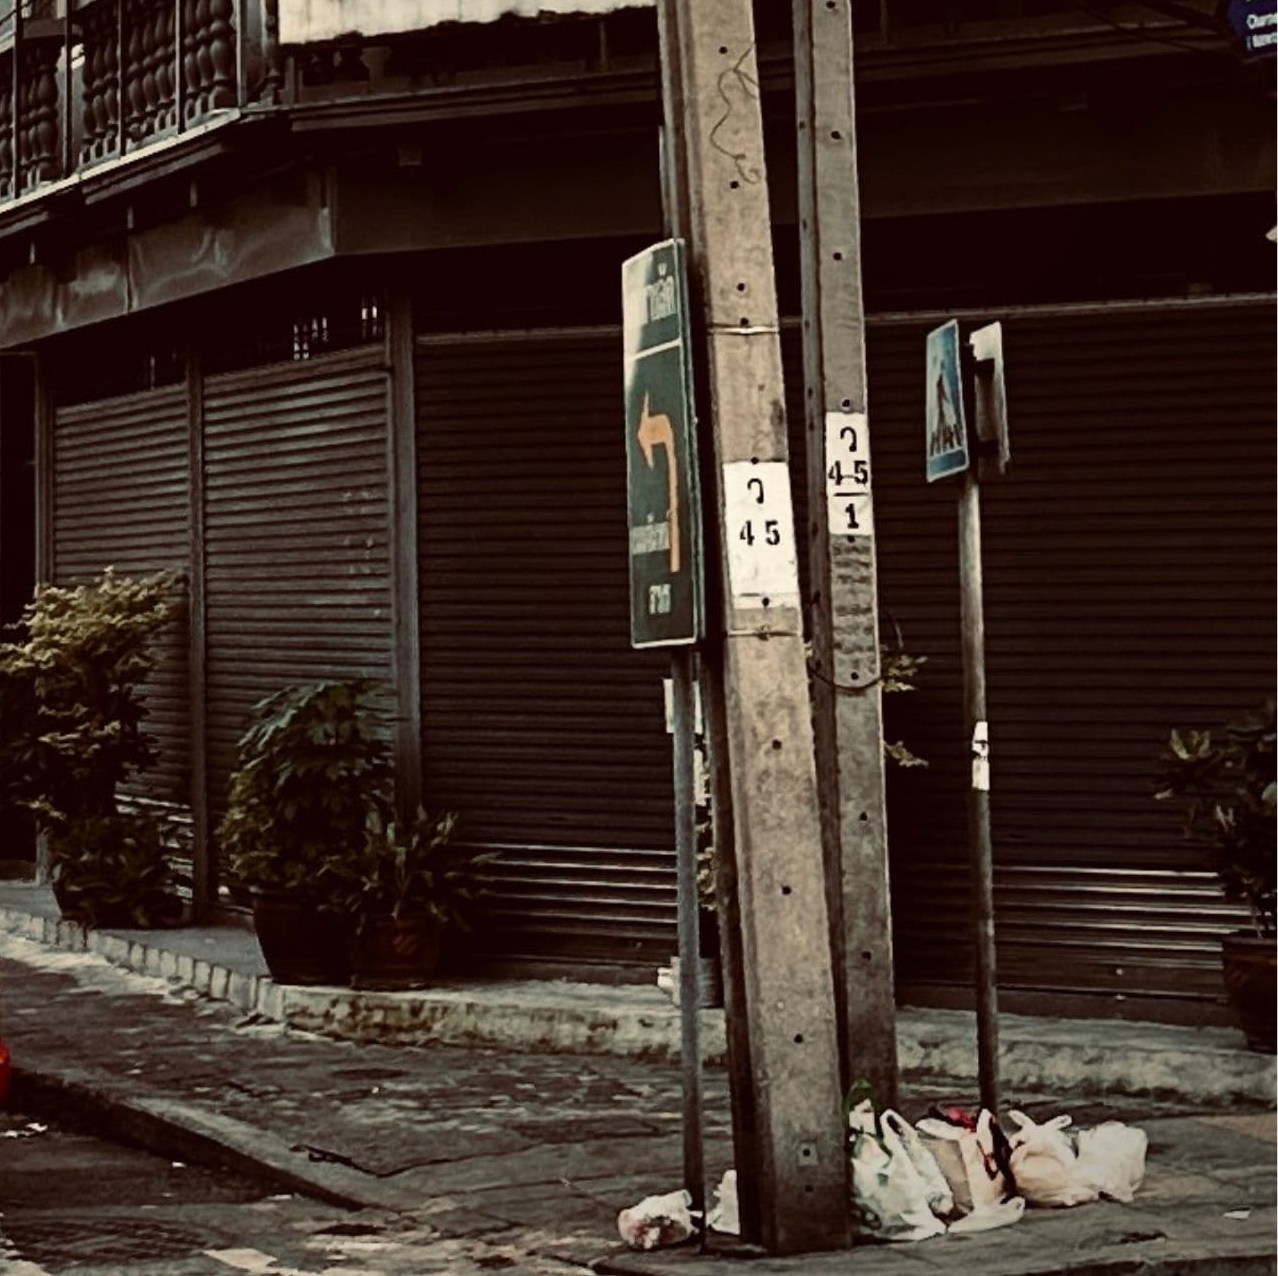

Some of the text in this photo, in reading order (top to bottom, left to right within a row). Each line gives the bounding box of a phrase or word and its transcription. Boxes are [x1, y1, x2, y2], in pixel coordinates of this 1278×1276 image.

[828, 460, 868, 486] 45
[846, 503, 859, 529] 1
[740, 520, 780, 546] 45
